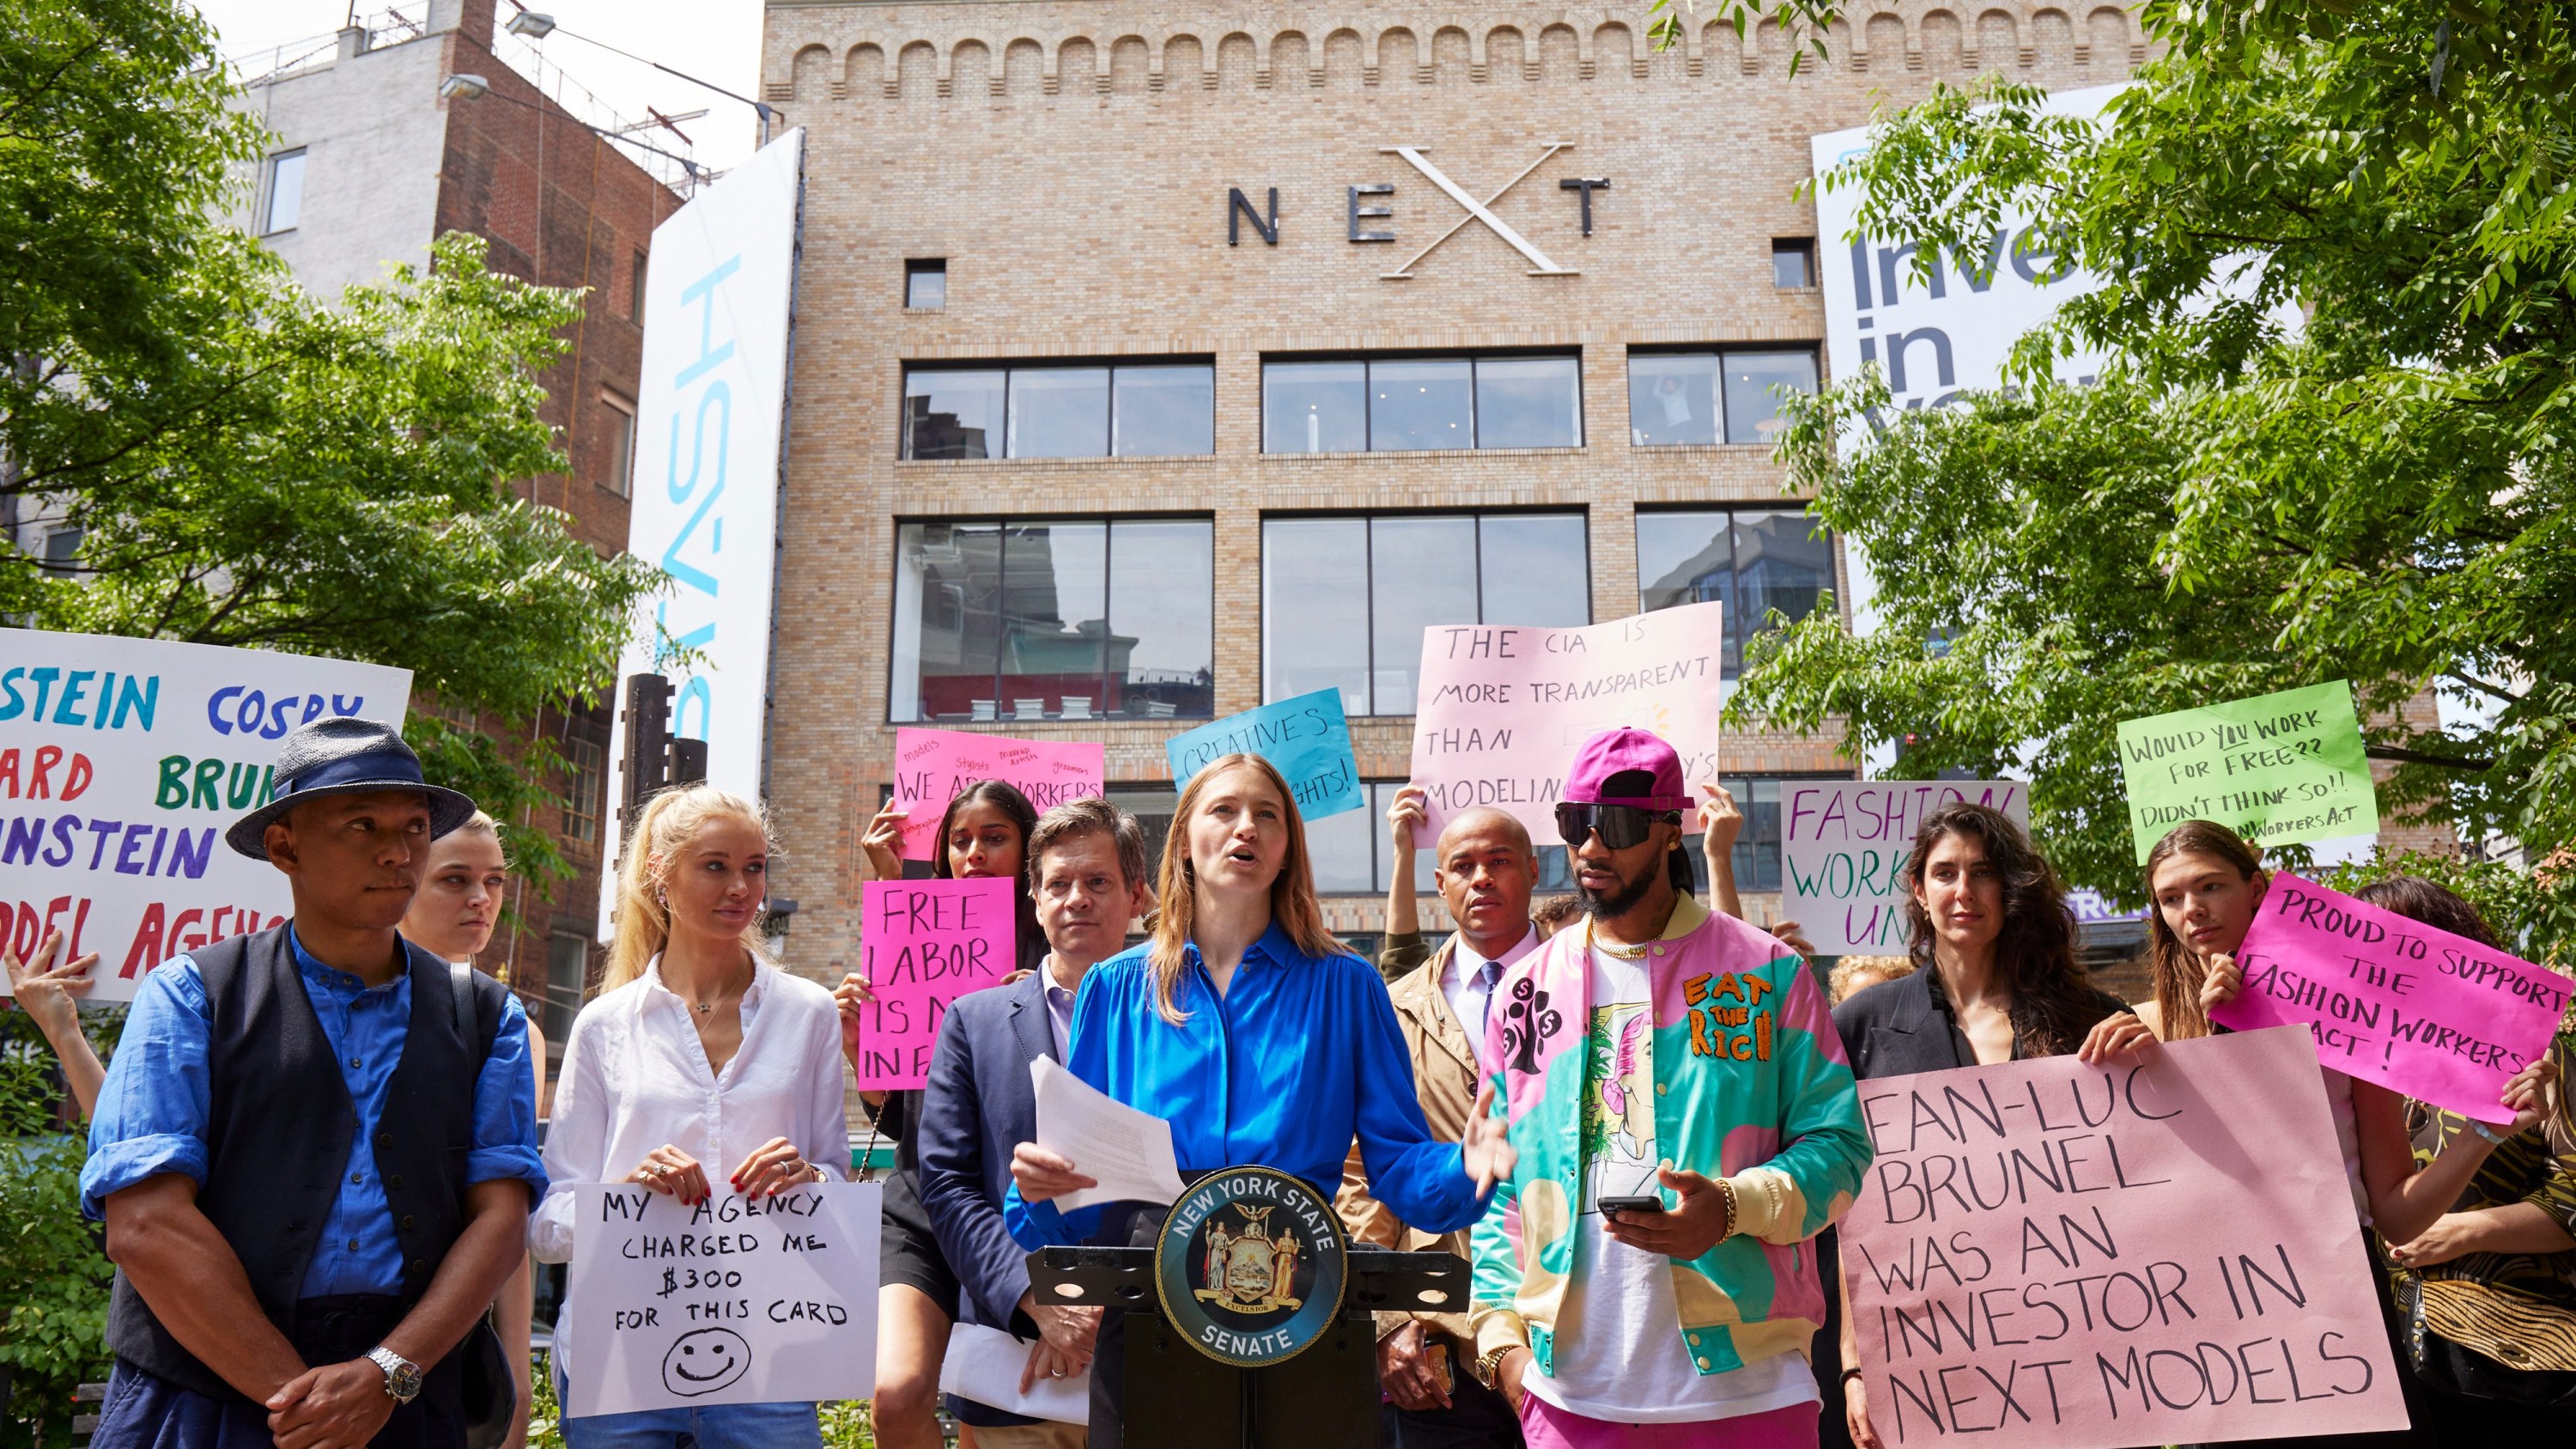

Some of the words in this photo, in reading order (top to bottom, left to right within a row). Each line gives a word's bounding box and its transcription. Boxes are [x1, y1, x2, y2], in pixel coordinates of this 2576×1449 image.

[1229, 142, 1611, 279] NEXT
[1444, 628, 1518, 659] THE
[1546, 634, 1587, 654] CIA
[1625, 618, 1648, 642] IS
[1432, 684, 1511, 705] MORE
[1530, 656, 1710, 703] TRANSPARENT
[1425, 728, 1512, 755] THAN
[2211, 724, 2249, 751] YOU
[2254, 709, 2322, 740] WORK
[904, 740, 939, 763] models
[2169, 761, 2210, 784] FOR
[2224, 738, 2322, 776] FREE??
[899, 772, 934, 801] WE
[1002, 779, 1100, 807] ORKERS
[1423, 778, 1566, 811] MODELIN
[2140, 791, 2210, 828] DIDN'T
[2221, 787, 2291, 812] THINK
[2298, 771, 2348, 802] SO!!
[0, 814, 216, 880] NSTEIN
[884, 890, 988, 935] FREE
[866, 939, 994, 989] LABOR
[2279, 889, 2385, 943] PROUD
[2392, 934, 2427, 960] TO
[2438, 949, 2570, 1013] SUPPORT
[1682, 971, 1773, 1007] EAT
[2342, 955, 2419, 995] THE
[876, 1000, 908, 1034] IS
[1709, 1005, 1749, 1028] THE
[2242, 953, 2381, 1030] FASHION
[2391, 1008, 2526, 1075] WORKERS
[865, 1048, 900, 1078] IN
[1878, 1134, 2172, 1224] BRUNEL
[603, 1191, 653, 1222] MY
[690, 1192, 824, 1225] AGENCY
[1172, 1189, 1215, 1238] NEW
[1218, 1177, 1280, 1199] YORK
[1283, 1189, 1335, 1252] STATE
[623, 1233, 758, 1259] CHARGED
[783, 1233, 827, 1253] ME
[1859, 1231, 1992, 1295] WAS
[2021, 1205, 2118, 1275] AN
[657, 1267, 743, 1299] $300
[1880, 1260, 2196, 1363] INVESTOR
[2218, 1243, 2306, 1321] IN
[616, 1307, 659, 1330] FOR
[686, 1299, 749, 1321] THIS
[768, 1300, 848, 1325] CARD
[1225, 1301, 1269, 1312] EXCELSIOR
[1200, 1324, 1293, 1356] SENATE
[1889, 1358, 2073, 1444] NEXT
[2095, 1331, 2373, 1420] MODELS
